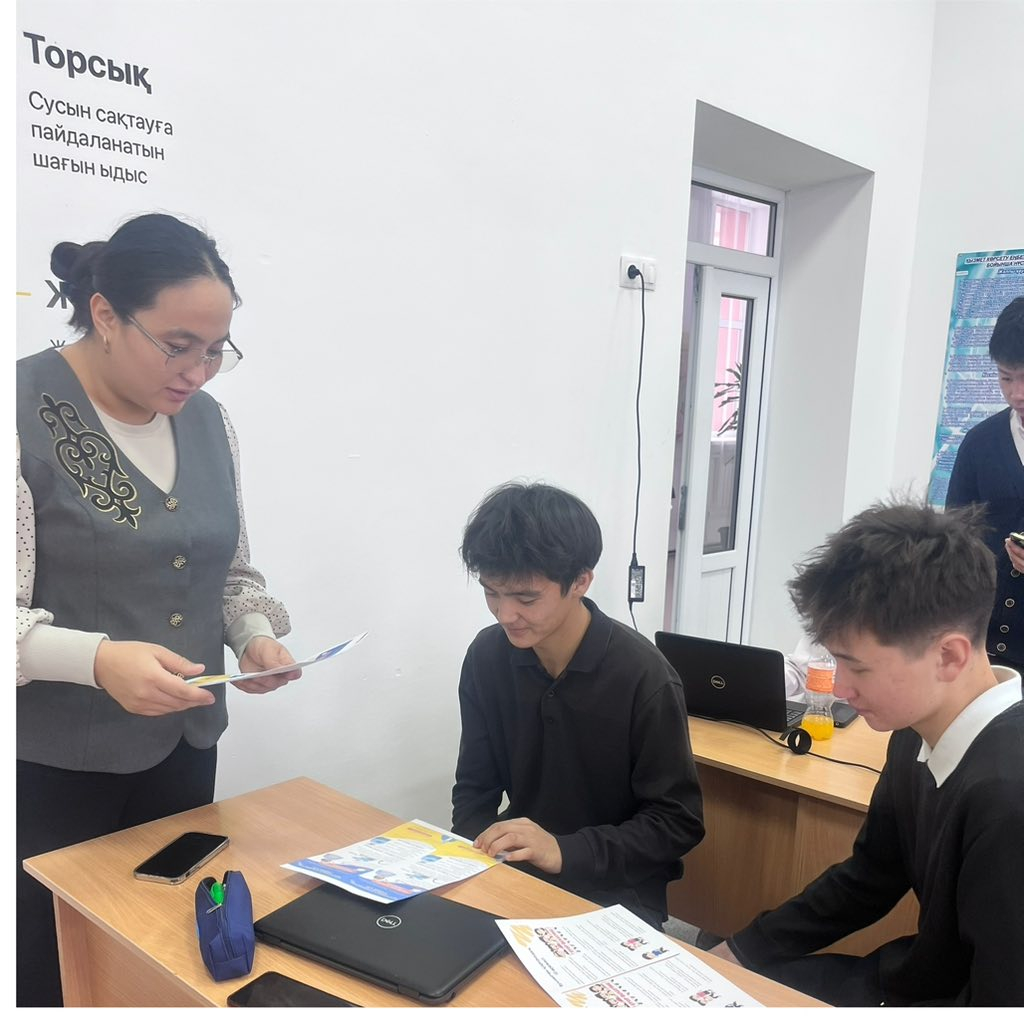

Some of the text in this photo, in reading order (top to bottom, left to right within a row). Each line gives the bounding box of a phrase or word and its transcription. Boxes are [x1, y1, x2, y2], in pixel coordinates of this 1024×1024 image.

[23, 31, 152, 94] Торсық
[28, 90, 173, 135] Сусын сақтауға
[31, 123, 164, 160] пайдаланатын
[33, 153, 148, 184] шағын ыдыс
